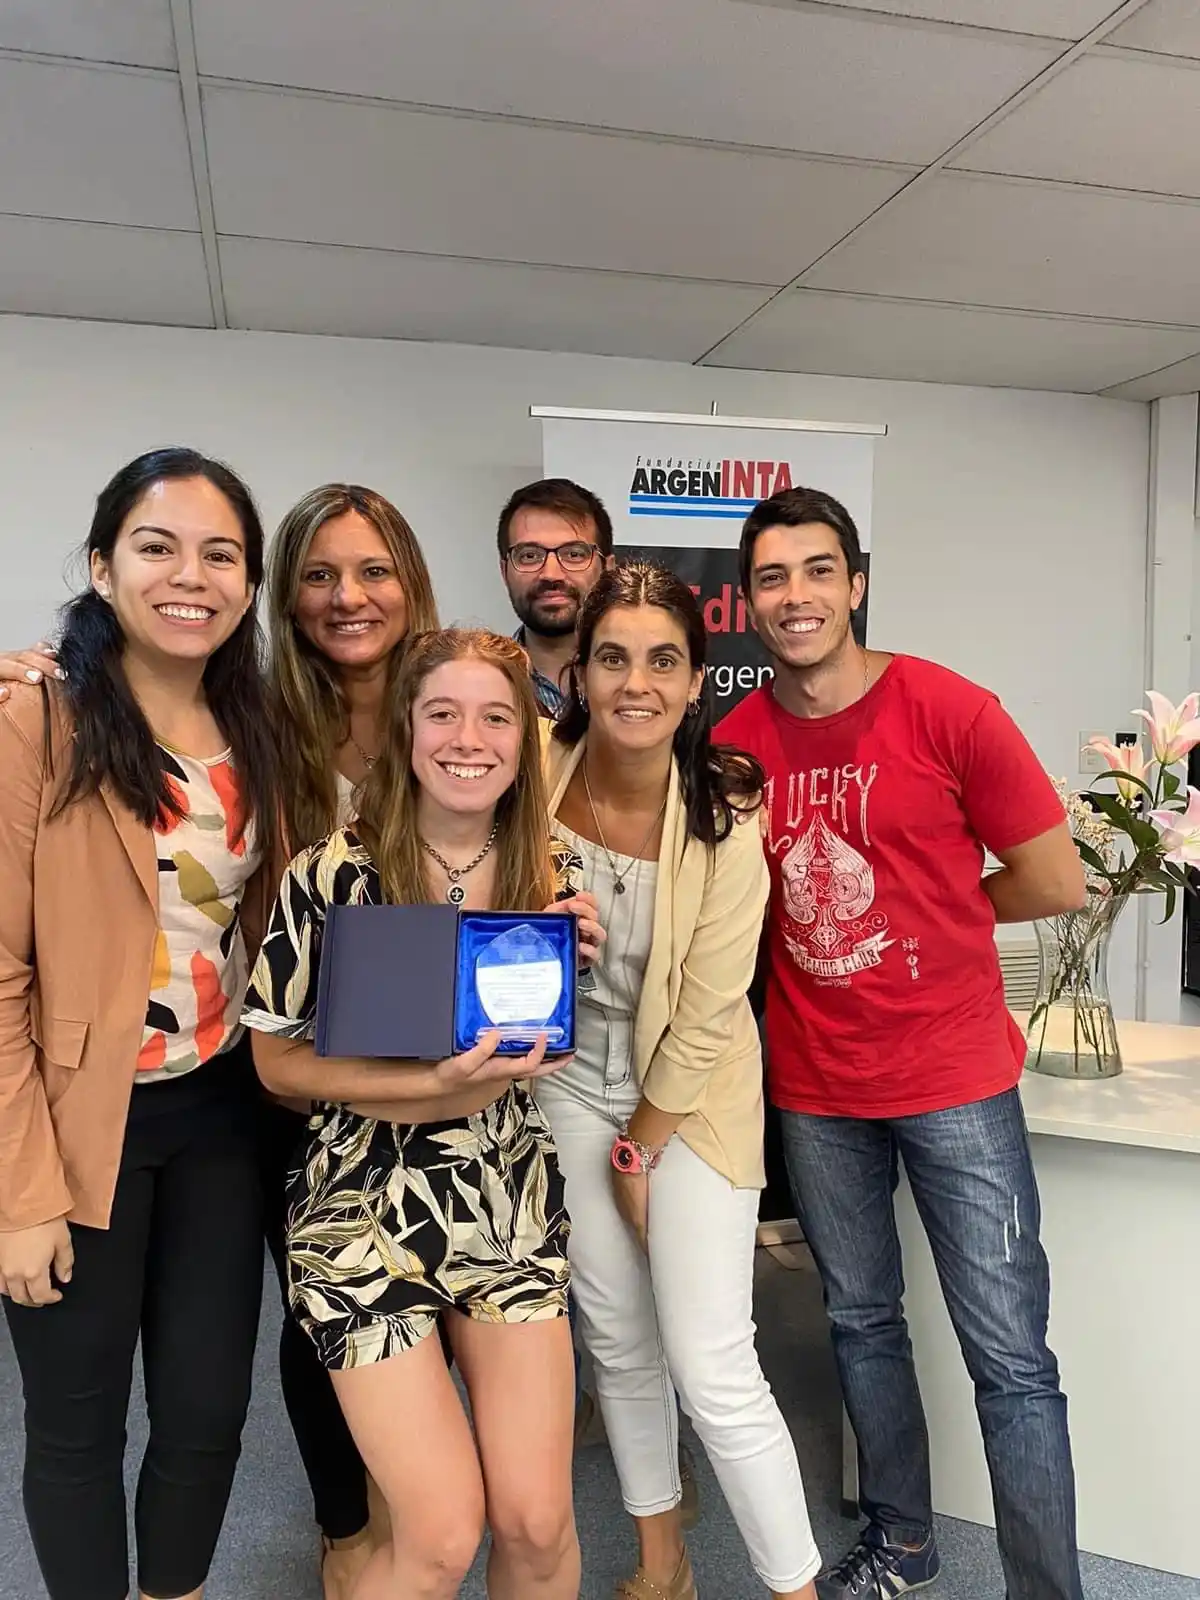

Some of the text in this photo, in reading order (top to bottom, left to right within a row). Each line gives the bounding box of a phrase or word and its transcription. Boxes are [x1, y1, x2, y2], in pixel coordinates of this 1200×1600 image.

[636, 455, 721, 470] Fundación
[706, 665, 775, 697] rgen
[763, 761, 879, 854] LUCKY
[842, 948, 879, 973] CLUB
